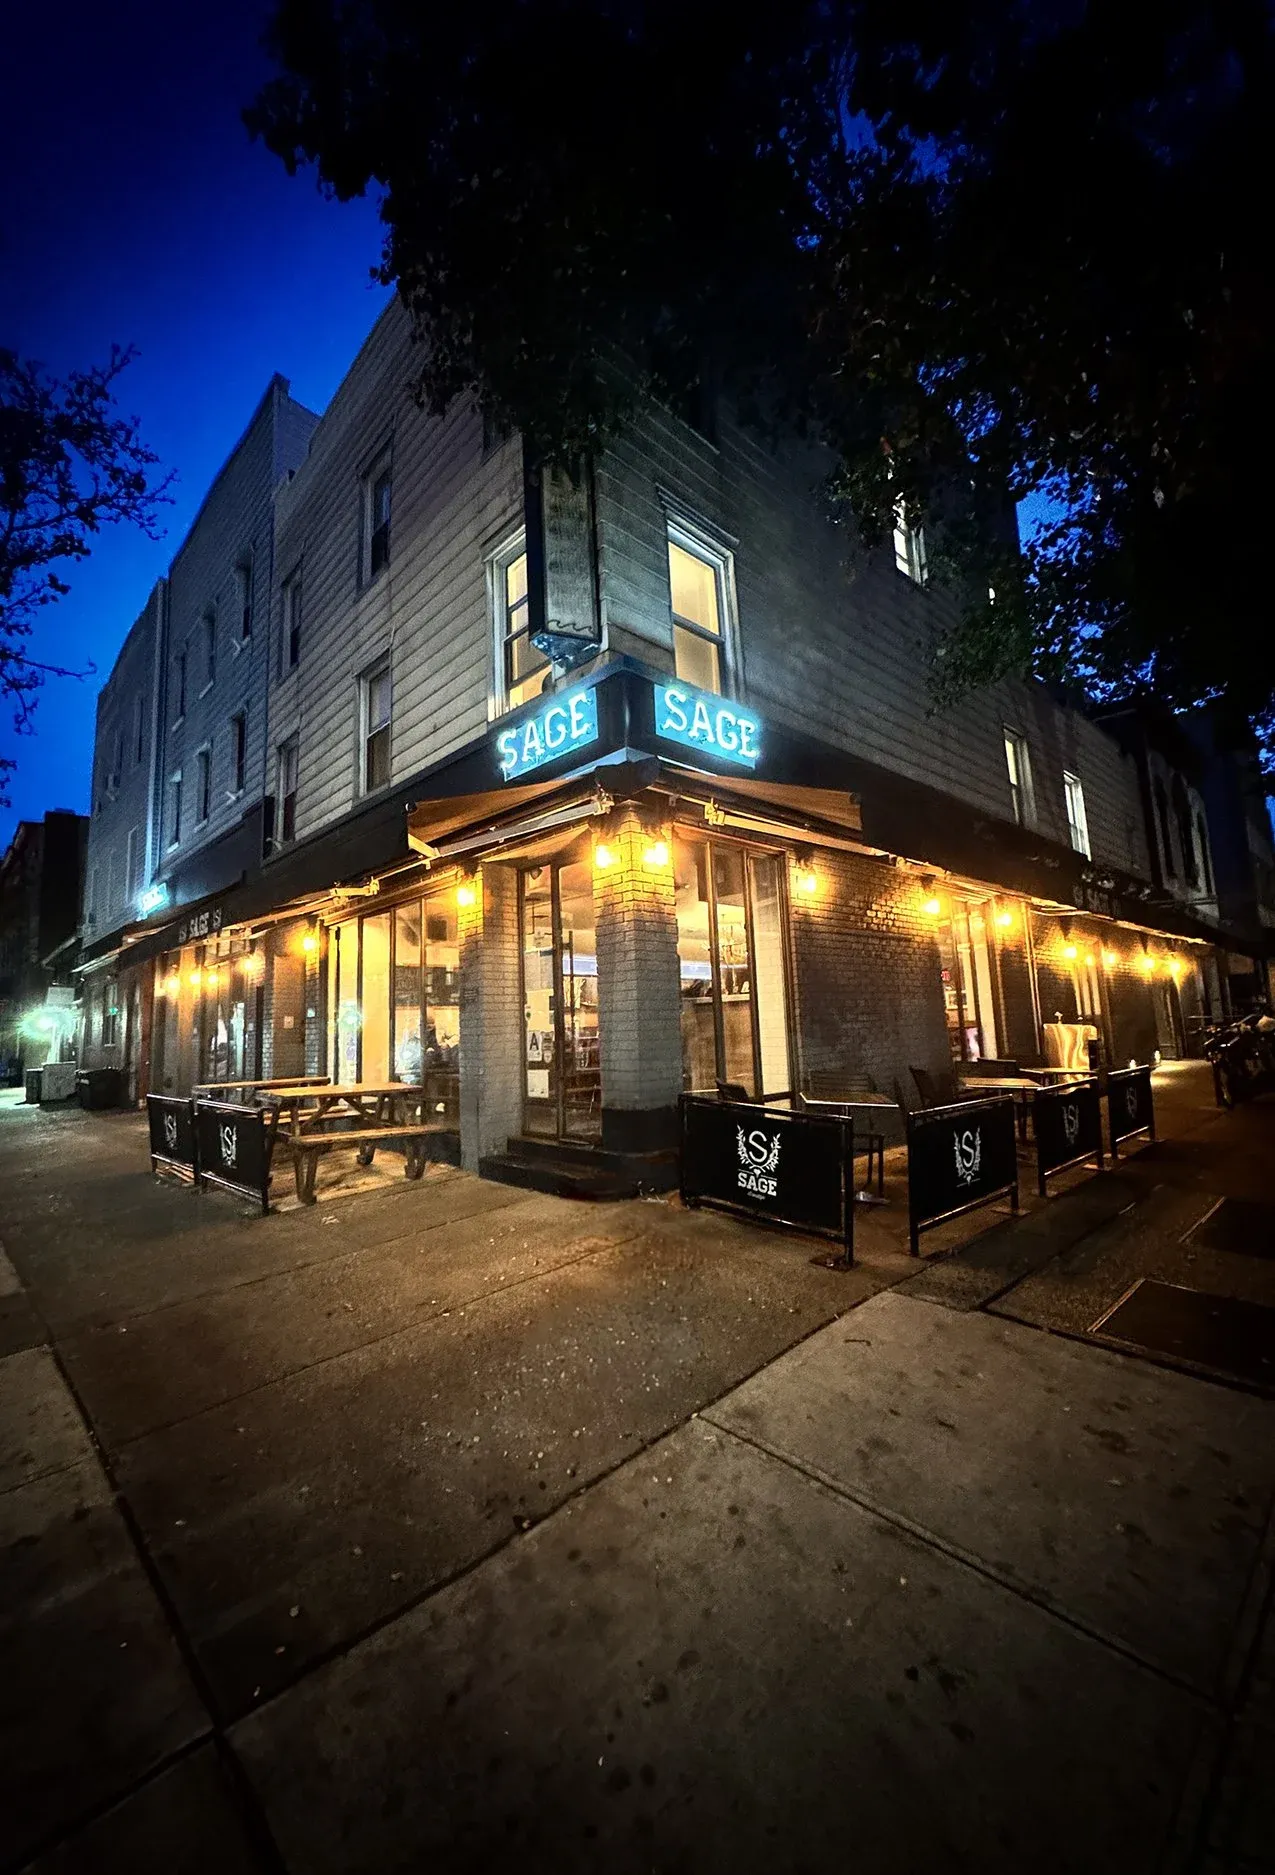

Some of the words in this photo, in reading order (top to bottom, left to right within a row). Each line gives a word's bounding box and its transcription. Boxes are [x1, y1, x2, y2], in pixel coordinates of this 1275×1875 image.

[498, 692, 592, 770] SAGE
[662, 689, 759, 758] SAGE
[529, 1032, 539, 1050] A
[224, 1126, 233, 1155] S
[748, 1130, 767, 1162] S
[961, 1130, 974, 1168] S
[737, 1172, 777, 1196] SAGE
